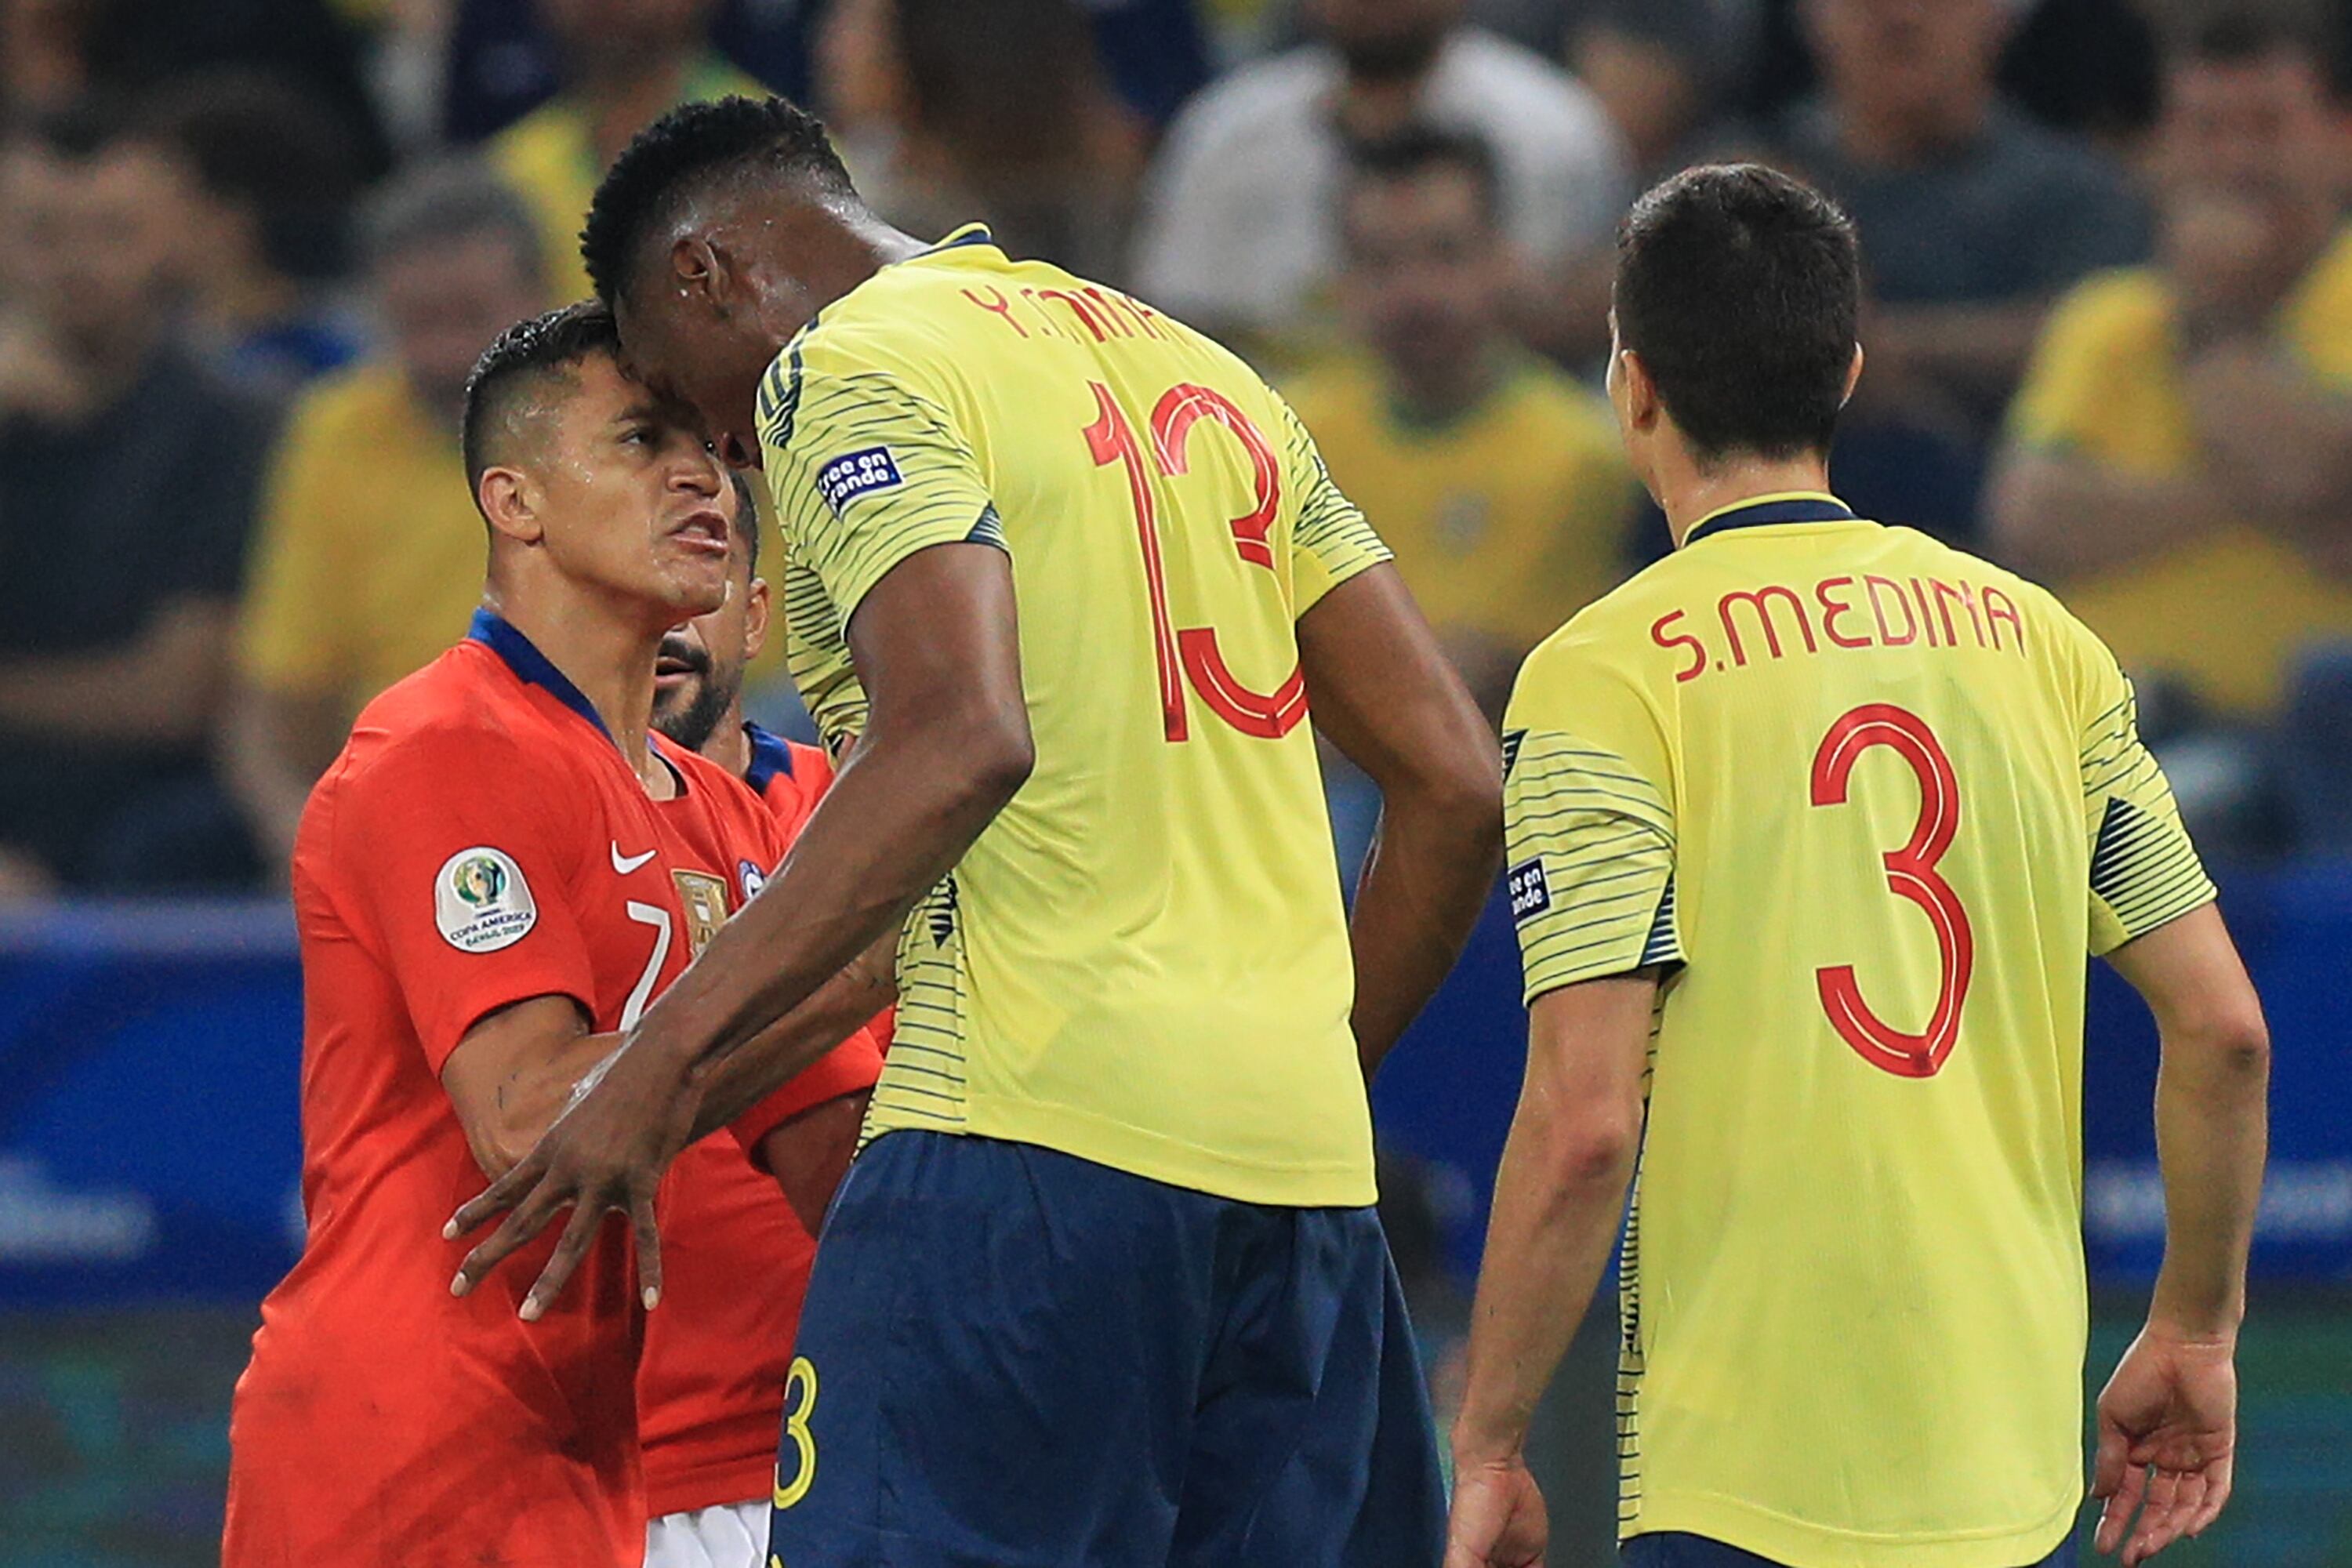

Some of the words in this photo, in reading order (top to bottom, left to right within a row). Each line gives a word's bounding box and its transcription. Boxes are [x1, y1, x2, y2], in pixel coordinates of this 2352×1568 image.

[858, 452, 887, 470] en
[1082, 380, 1310, 743] 13
[1651, 575, 2026, 682] S.MEDINA
[1810, 702, 1973, 1080] 3
[619, 900, 673, 1032] 7
